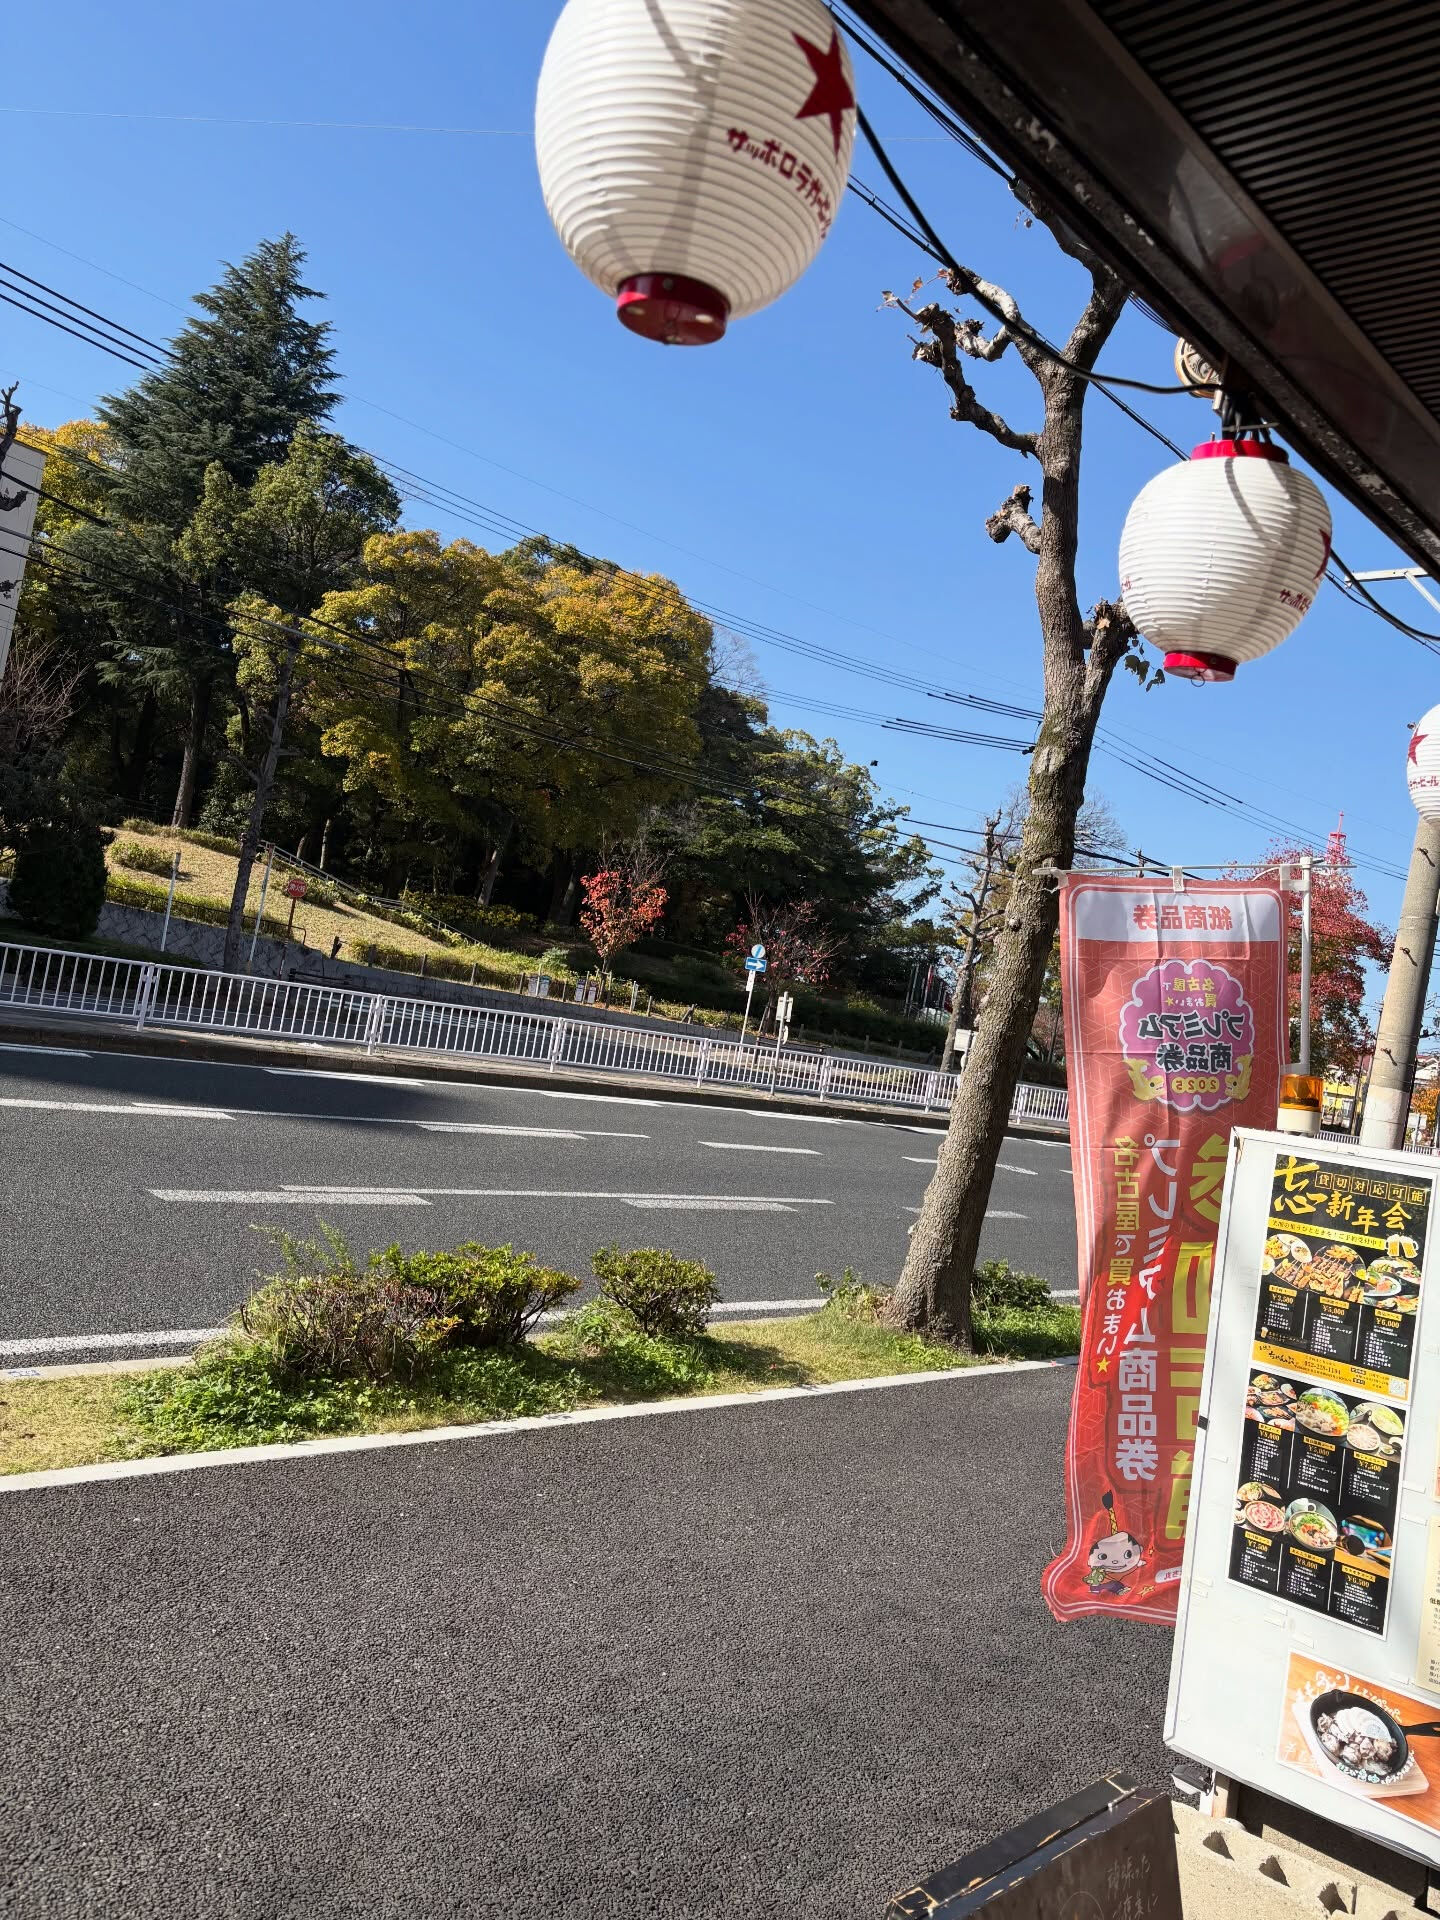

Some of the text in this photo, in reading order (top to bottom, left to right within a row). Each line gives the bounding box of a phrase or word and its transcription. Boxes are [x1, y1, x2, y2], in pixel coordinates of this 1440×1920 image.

[1273, 1155, 1412, 1234] 忘新年会
[1318, 1173, 1426, 1204] 貸切対応可能
